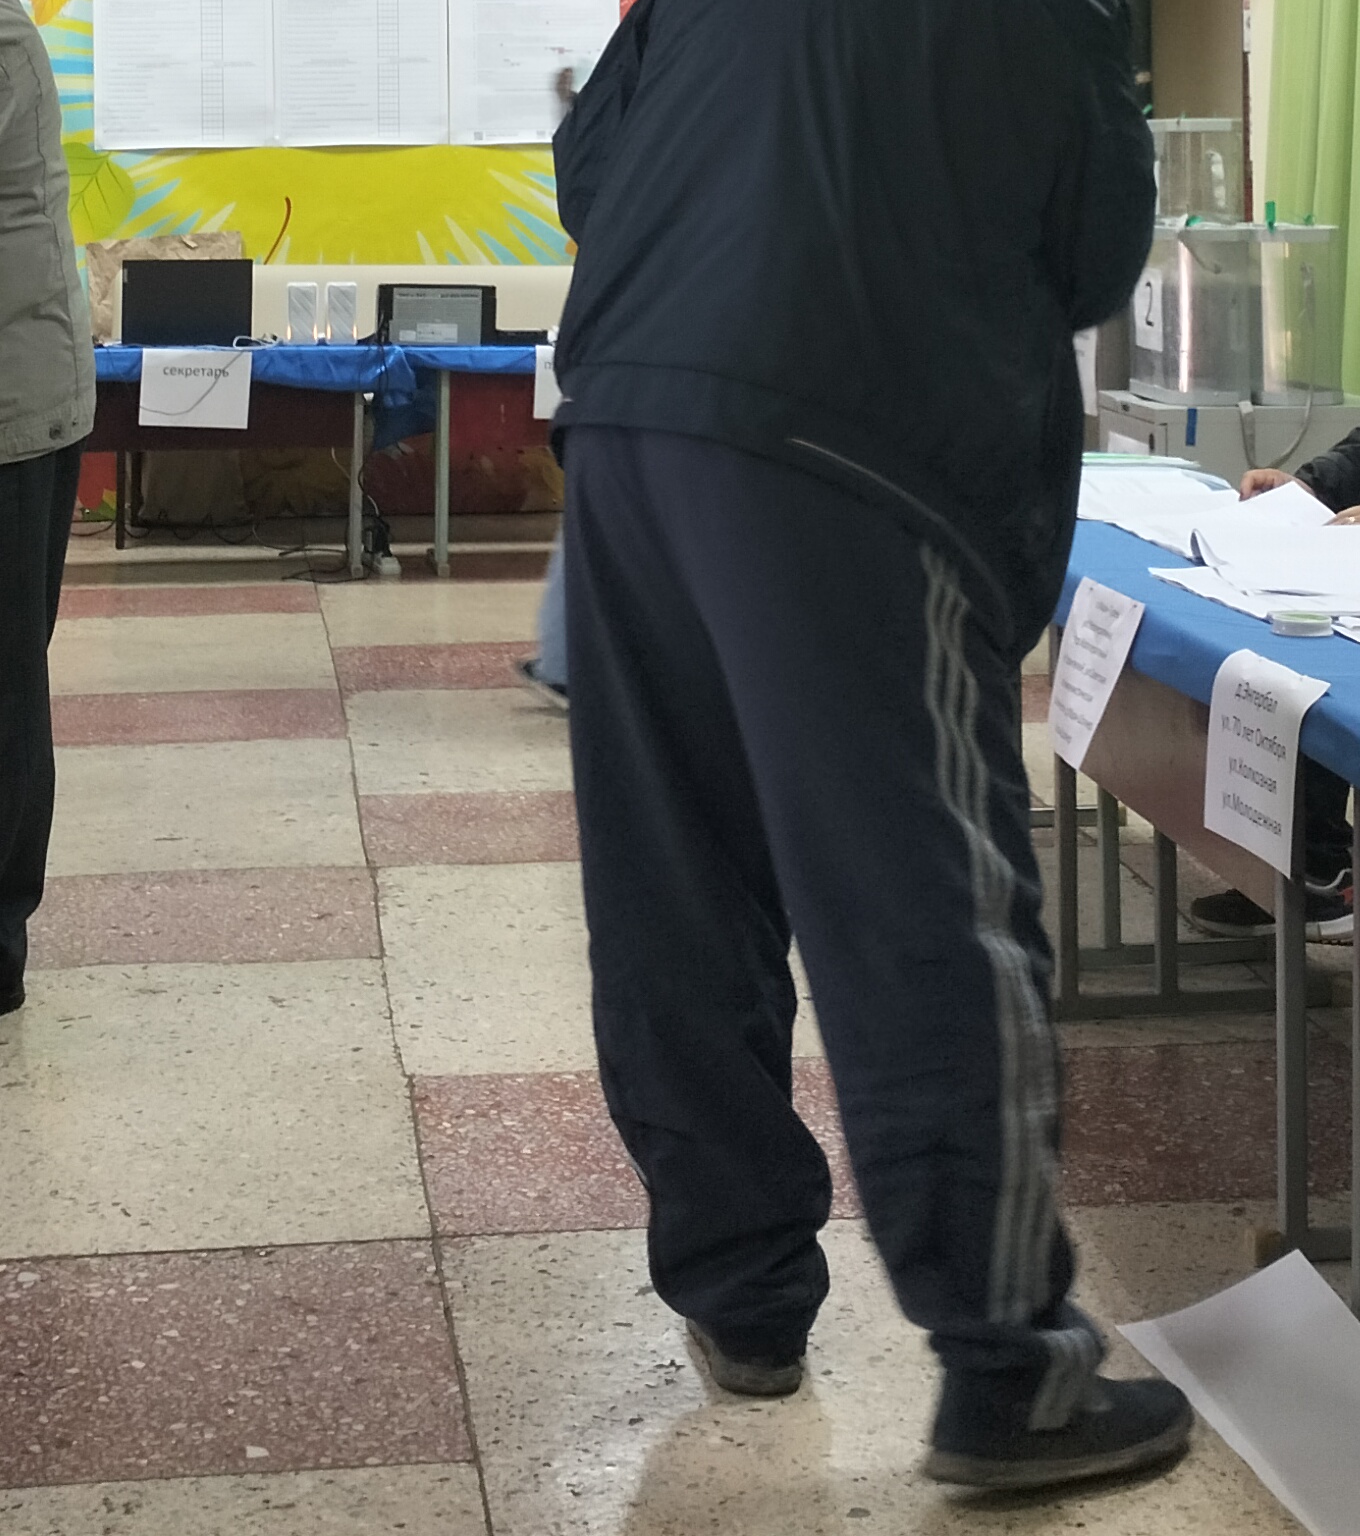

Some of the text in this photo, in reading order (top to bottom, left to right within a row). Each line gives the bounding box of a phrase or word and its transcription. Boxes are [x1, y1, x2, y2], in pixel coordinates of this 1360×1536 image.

[1144, 281, 1155, 328] 2
[163, 366, 230, 378] секретарь
[1255, 727, 1287, 762] Октября
